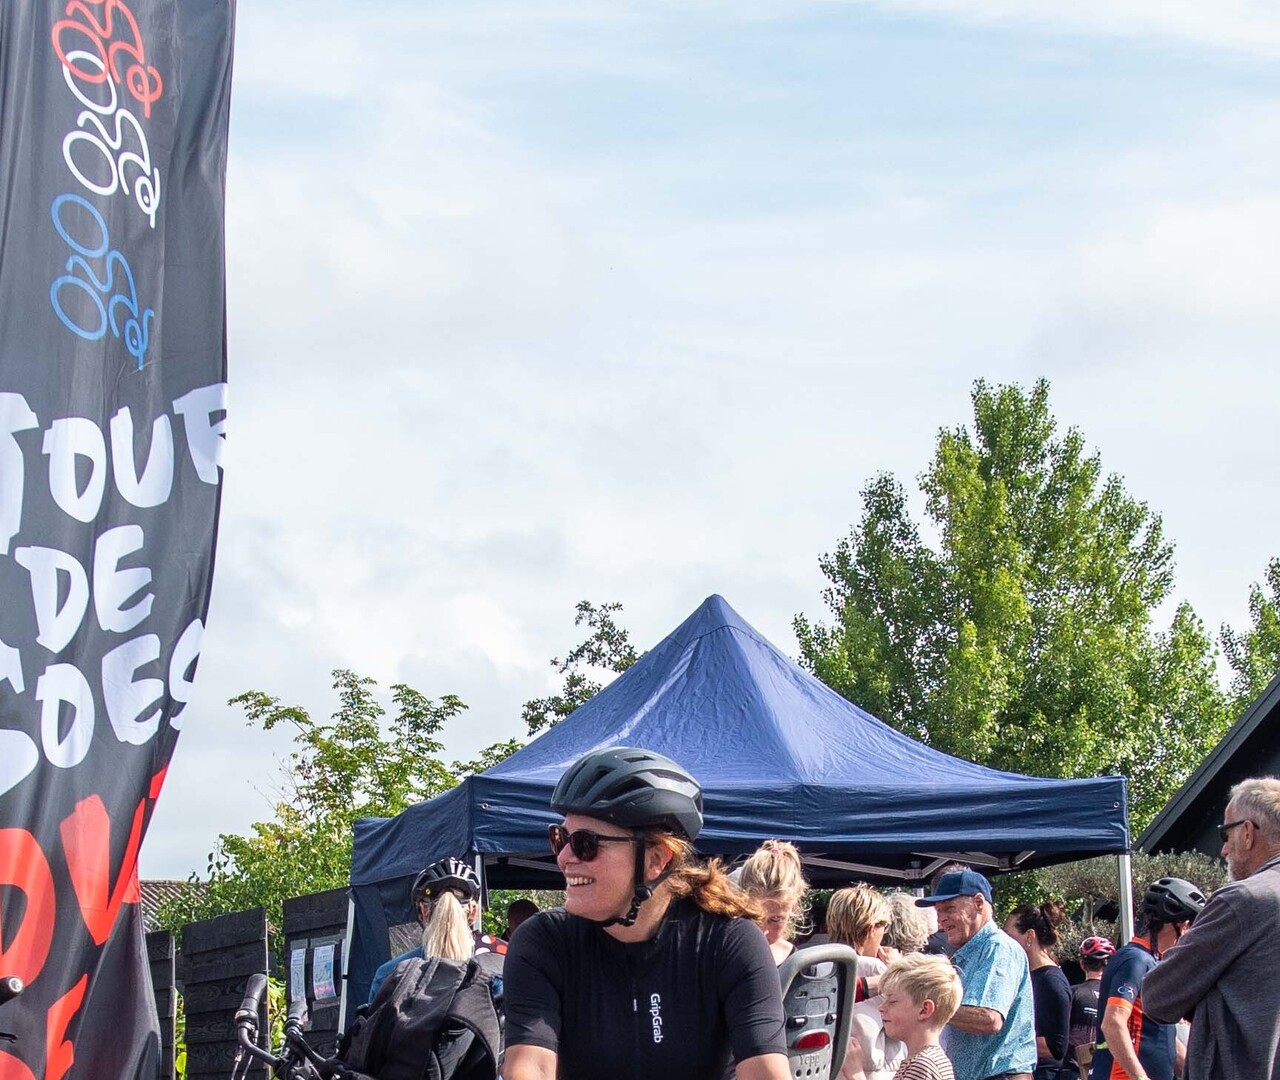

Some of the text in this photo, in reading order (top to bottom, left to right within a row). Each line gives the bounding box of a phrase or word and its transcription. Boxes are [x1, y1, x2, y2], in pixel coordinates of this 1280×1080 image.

[15, 524, 154, 653] DE
[649, 993, 664, 1043] GripGrab
[799, 1053, 820, 1066] Yepp
